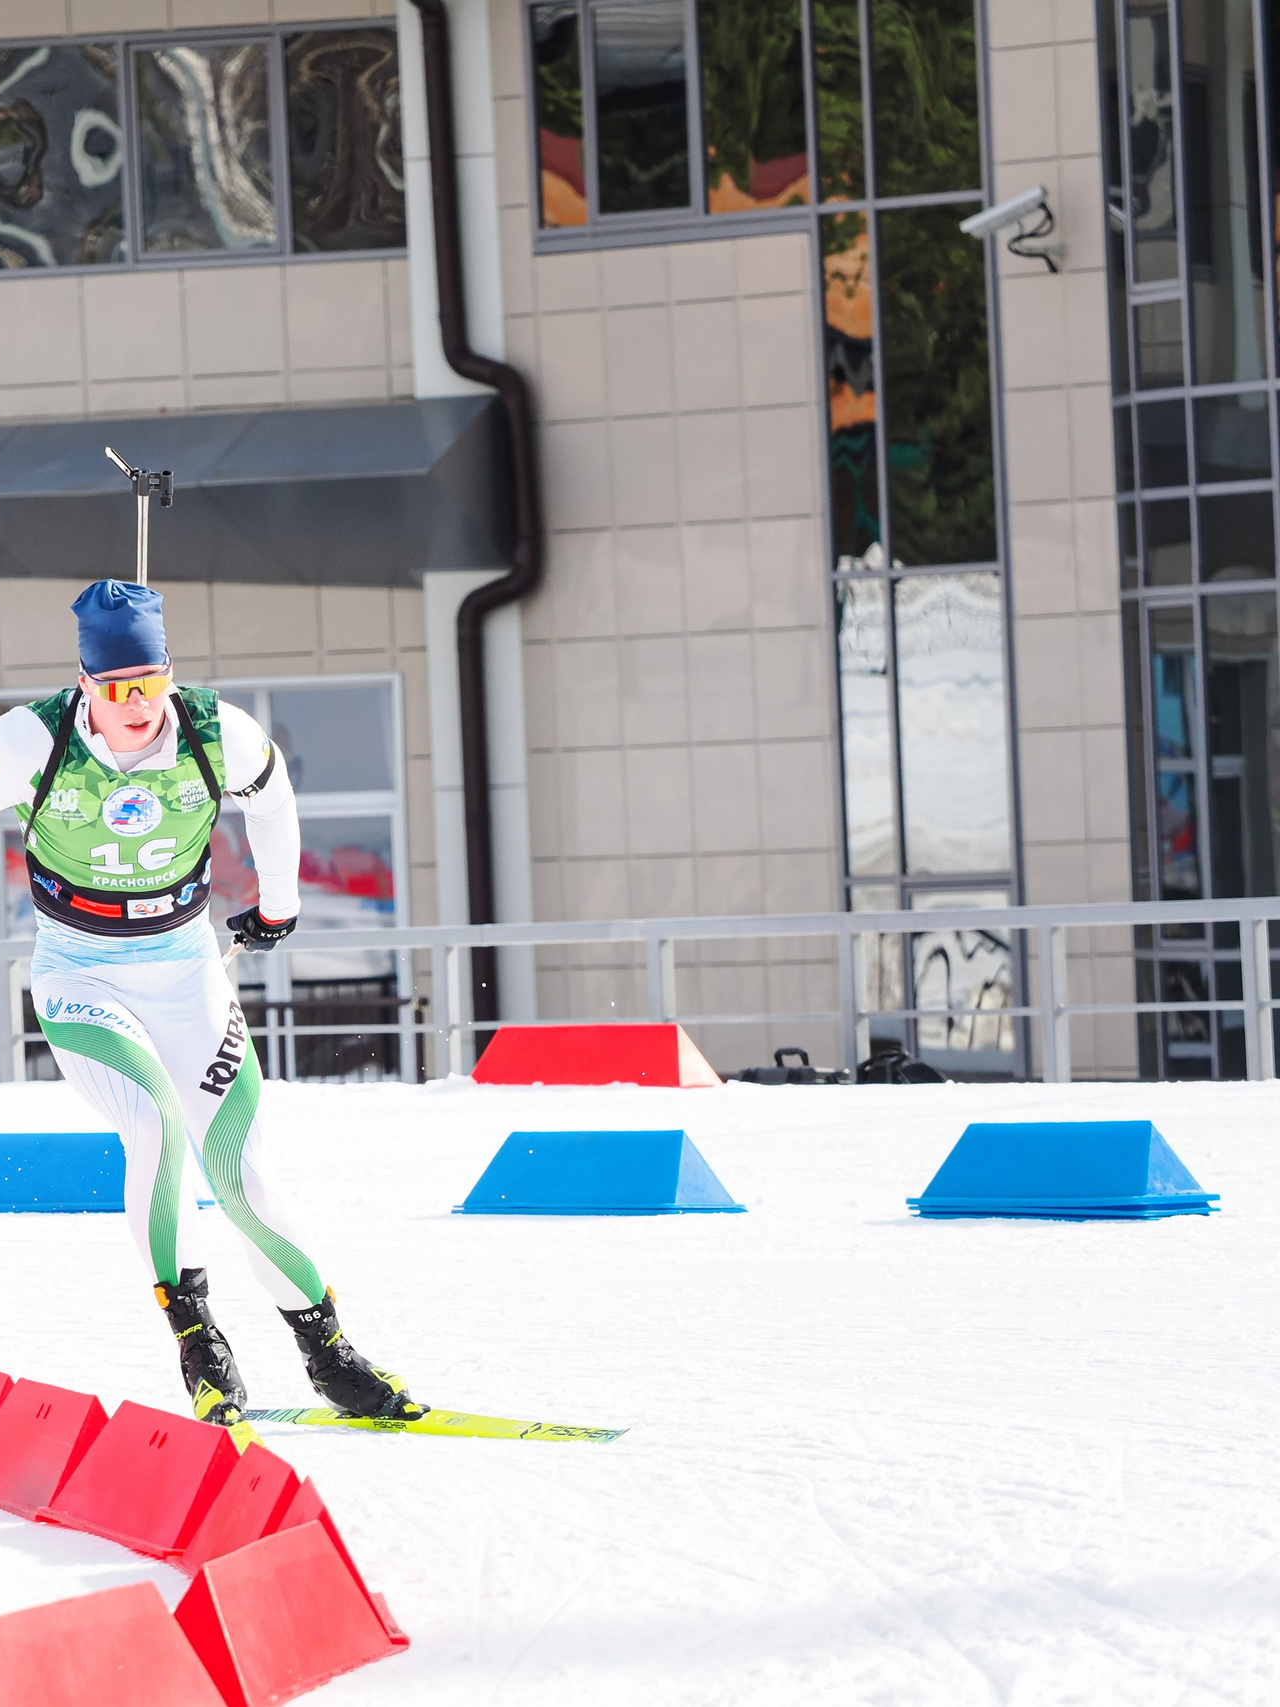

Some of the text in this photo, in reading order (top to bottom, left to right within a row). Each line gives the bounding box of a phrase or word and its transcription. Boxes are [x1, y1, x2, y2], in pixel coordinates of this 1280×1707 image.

[89, 837, 178, 875] 16
[92, 868, 178, 888] КРАСНОЯРСК
[60, 1016, 116, 1030] СТРАХОВАНИЕ
[63, 1002, 142, 1038] ЮГОРИ
[298, 1310, 322, 1323] 166
[373, 1420, 408, 1430] FISCHER
[542, 1425, 617, 1439] FISCHER
